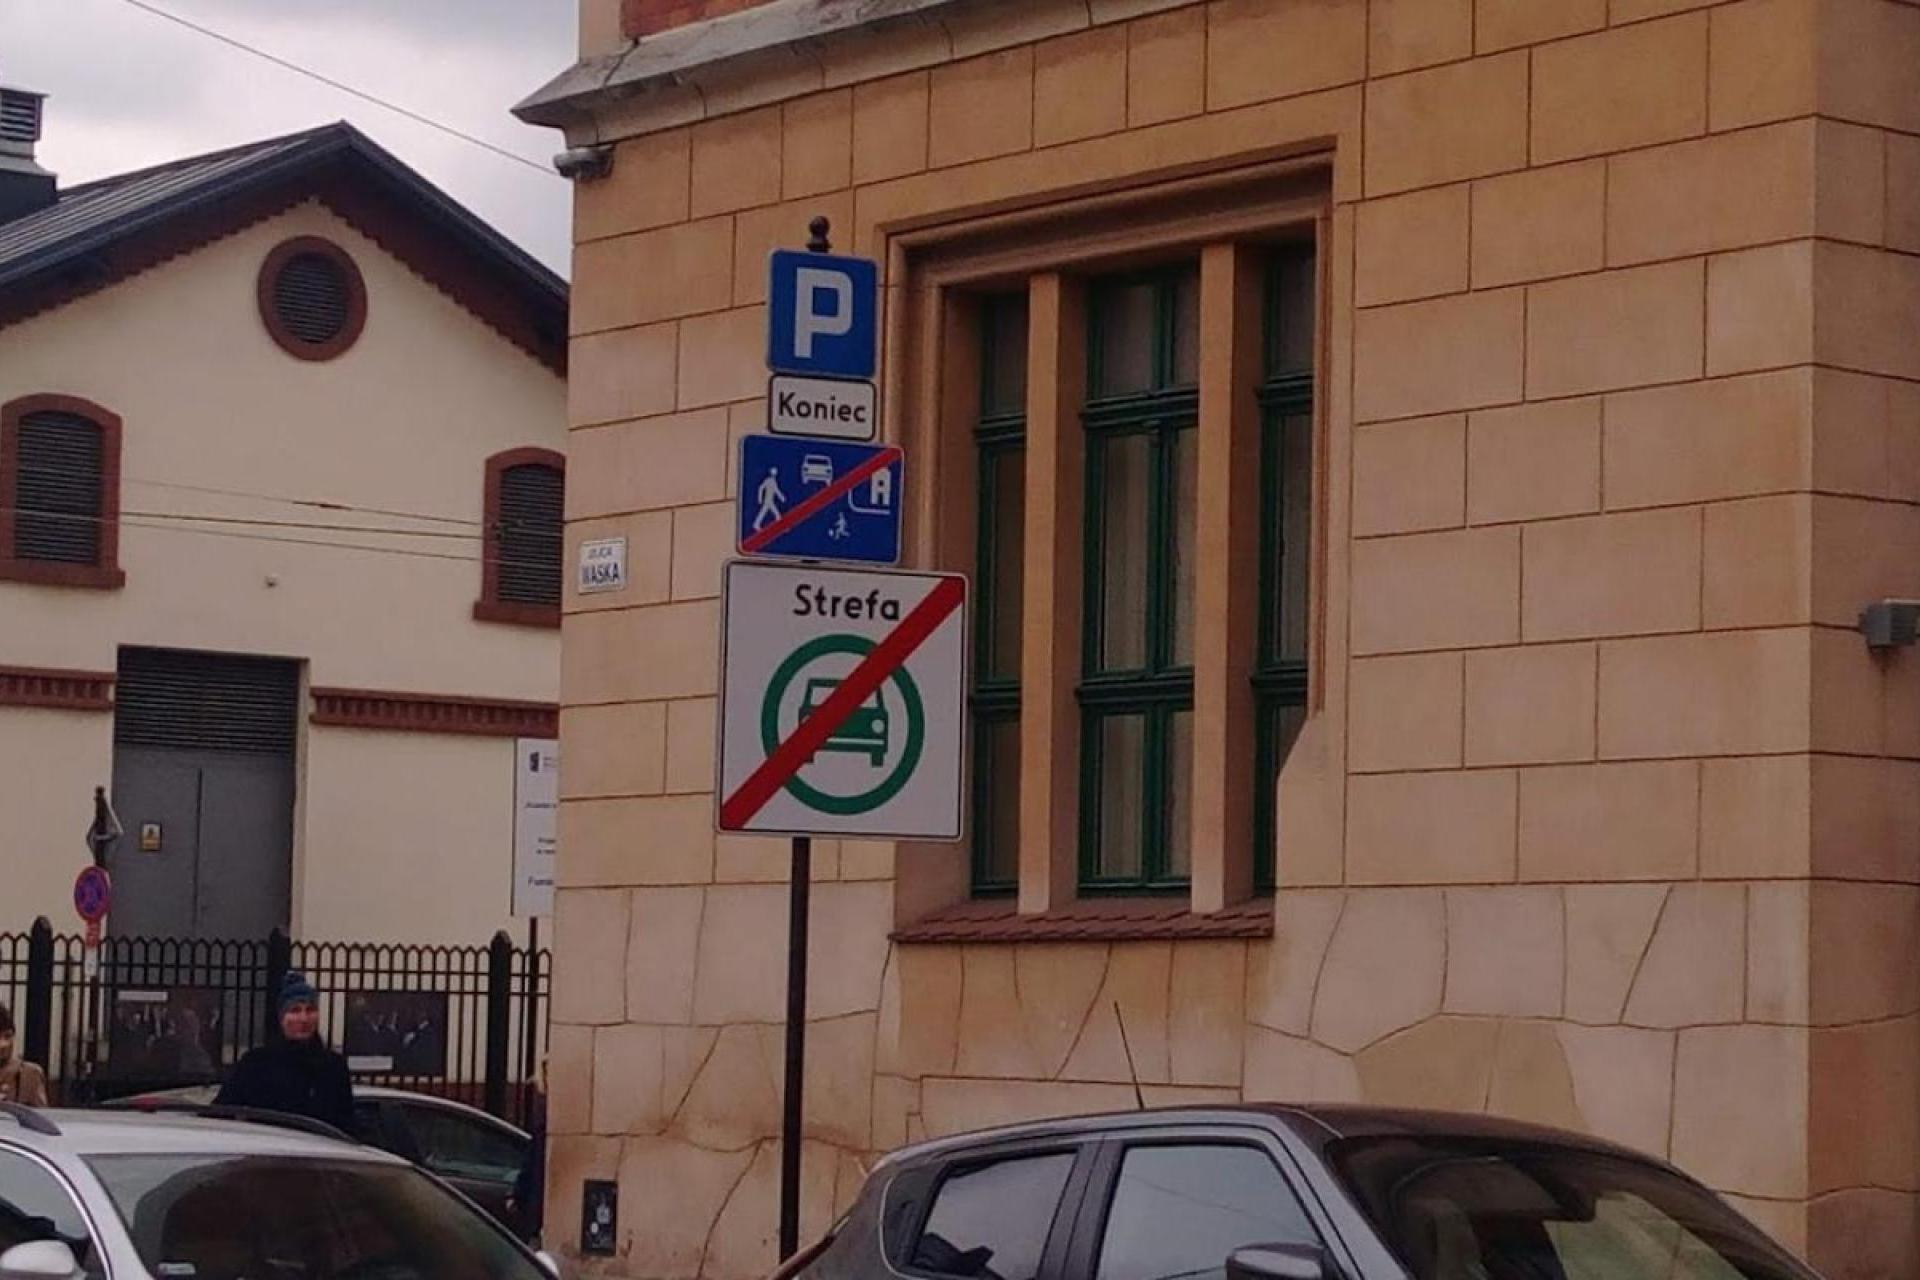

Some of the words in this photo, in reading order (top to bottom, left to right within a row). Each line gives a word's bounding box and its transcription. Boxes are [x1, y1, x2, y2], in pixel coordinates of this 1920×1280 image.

[794, 266, 854, 358] P
[778, 391, 866, 423] Koniec
[793, 583, 900, 621] Strefa
